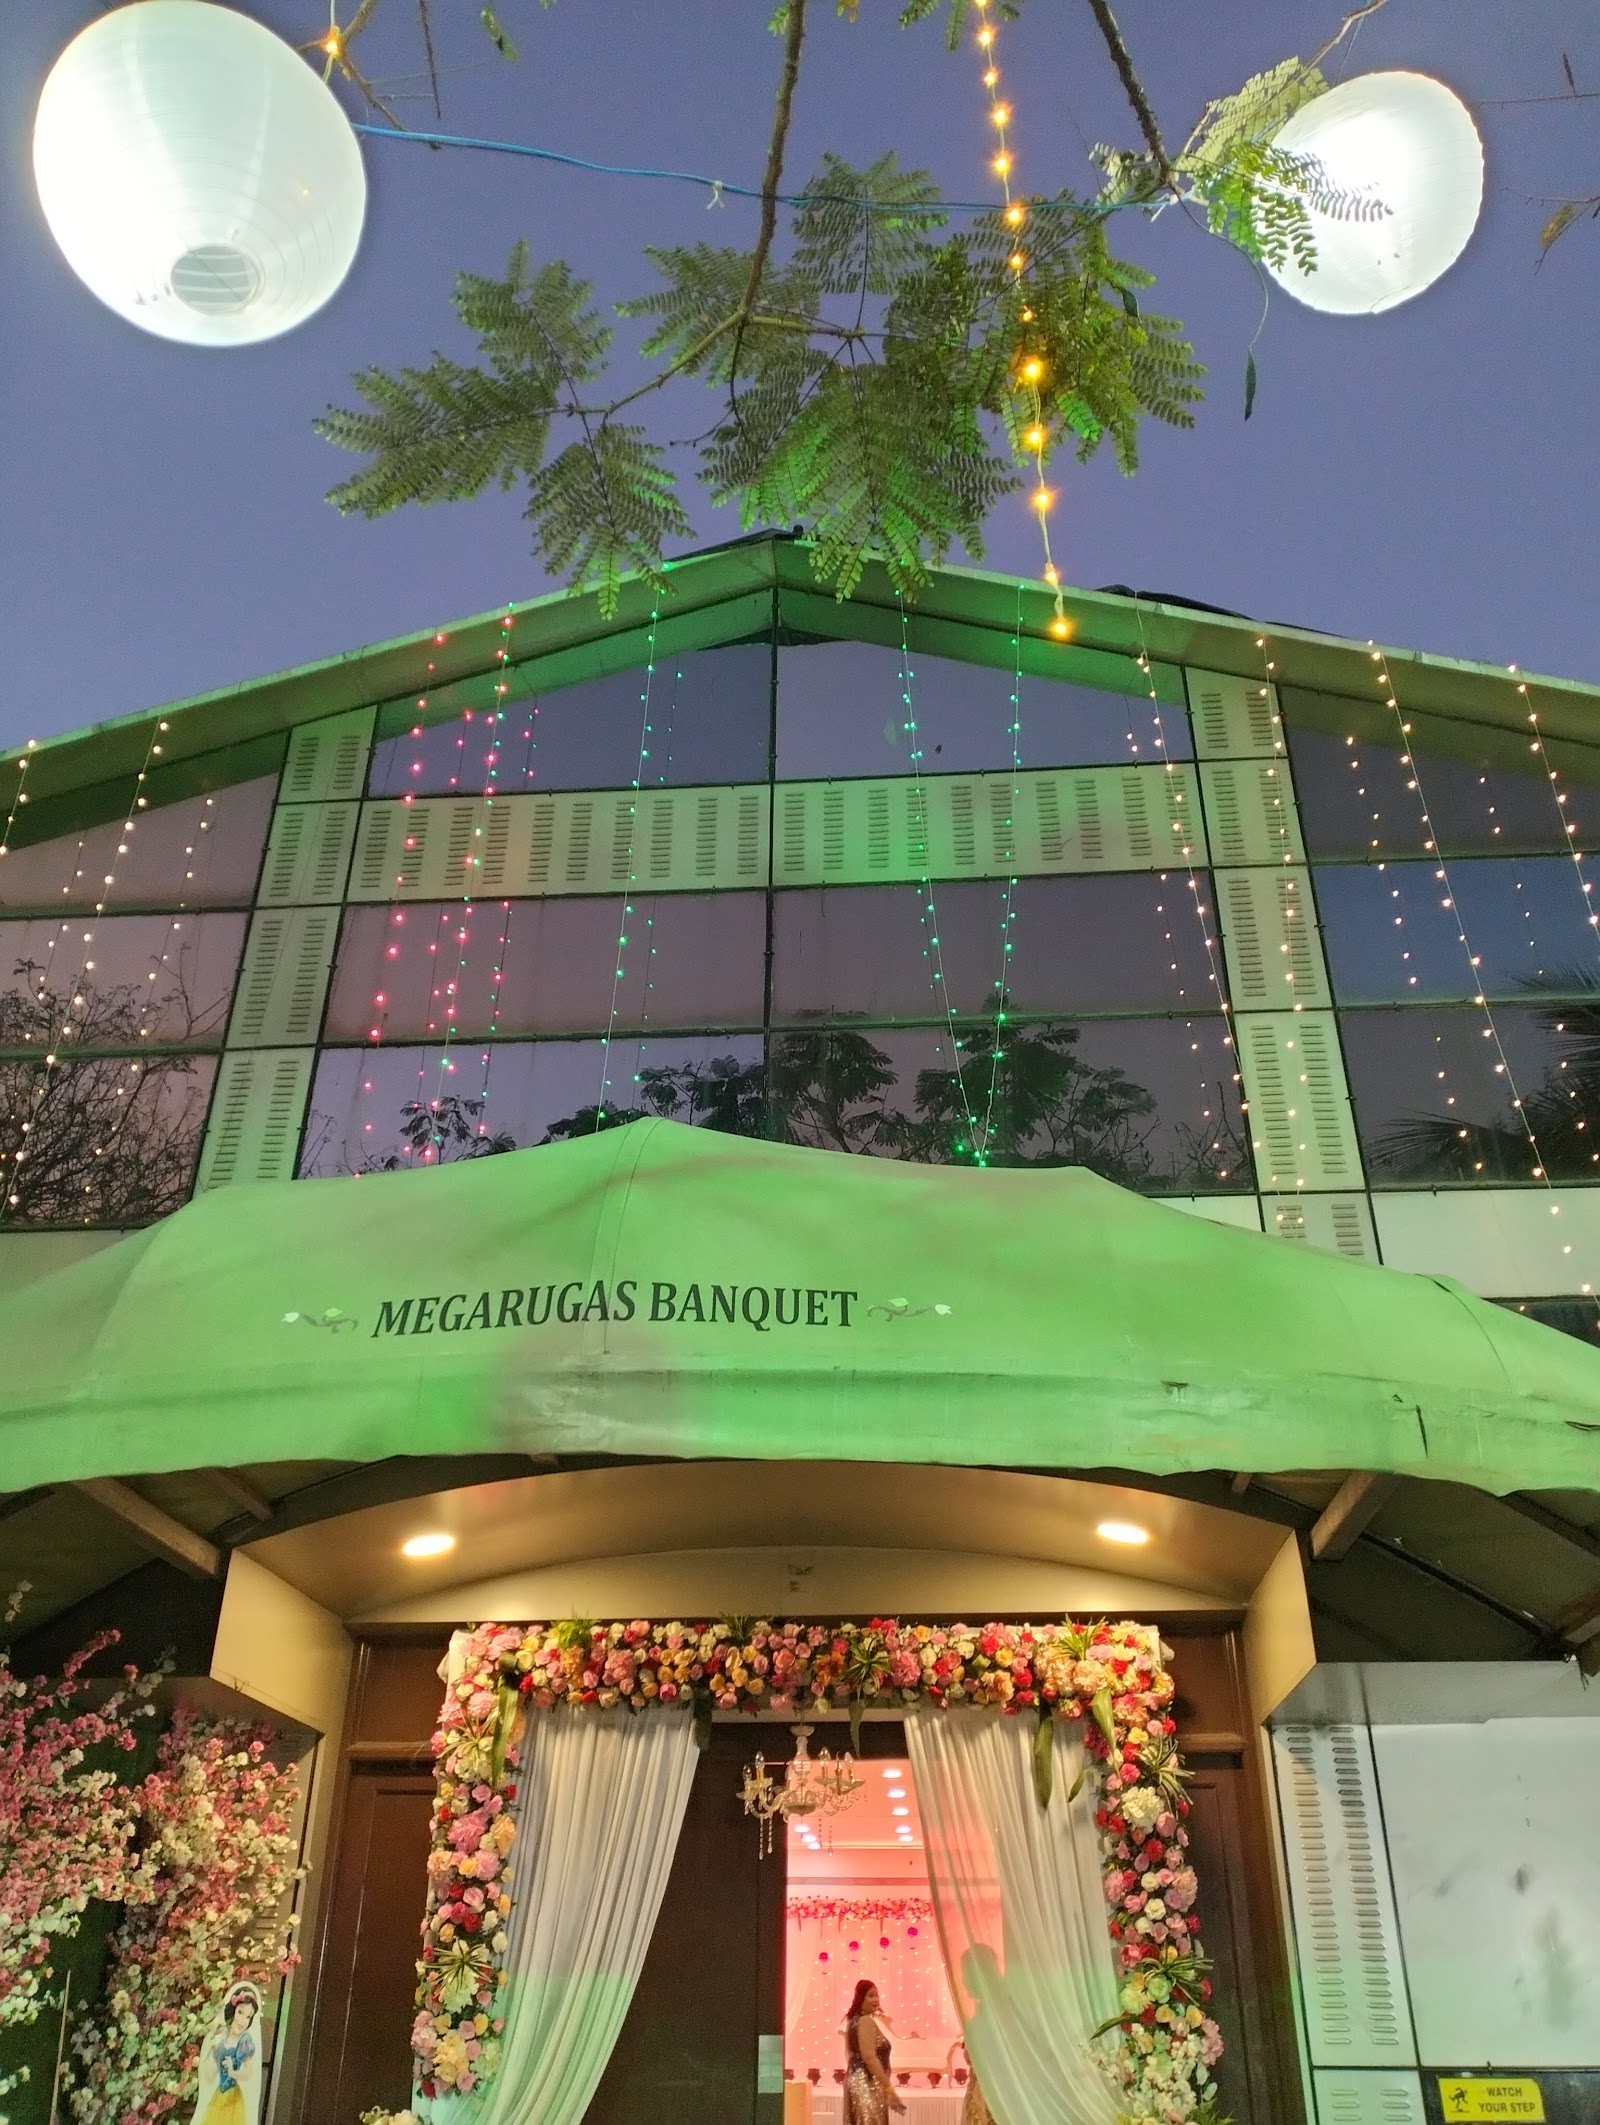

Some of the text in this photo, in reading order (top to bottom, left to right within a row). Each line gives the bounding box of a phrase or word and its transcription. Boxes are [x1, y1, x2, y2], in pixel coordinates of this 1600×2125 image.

[371, 1280, 859, 1339] MEGARUGAS BANQUET
[1486, 2087, 1523, 2097] WATCH
[1478, 2102, 1535, 2112] YOUR STEP
